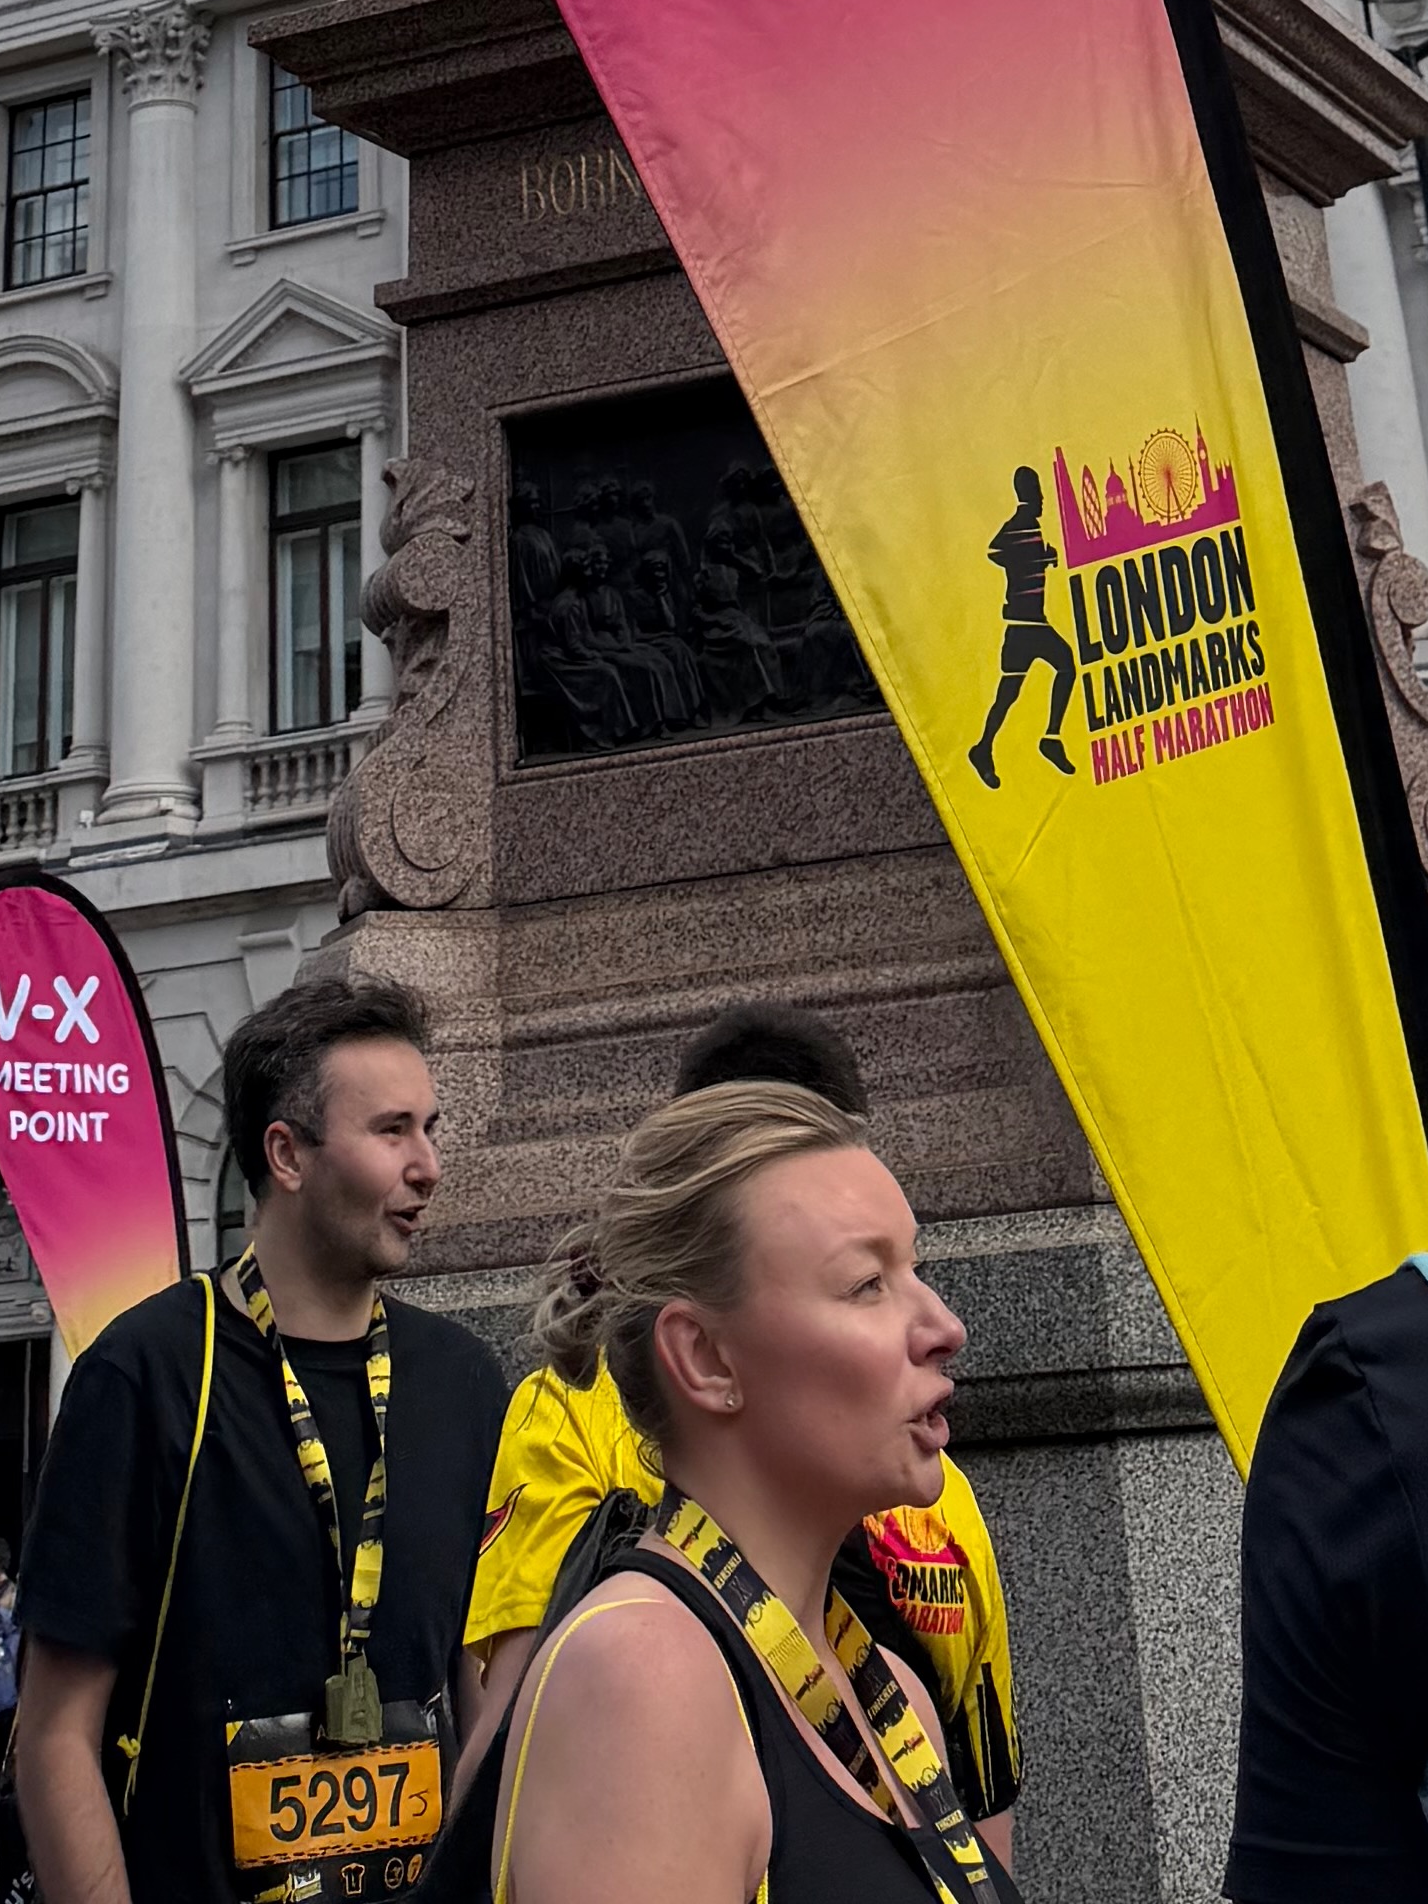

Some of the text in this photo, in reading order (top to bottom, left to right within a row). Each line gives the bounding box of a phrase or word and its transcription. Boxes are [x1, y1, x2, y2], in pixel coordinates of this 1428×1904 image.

[521, 147, 640, 226] BORN
[1069, 525, 1256, 665] LONDON
[1082, 620, 1265, 732] LANDMARKS
[1091, 682, 1275, 786] HALF MARATHON
[9, 1110, 109, 1142] POINT
[270, 1762, 409, 1841] 5297
